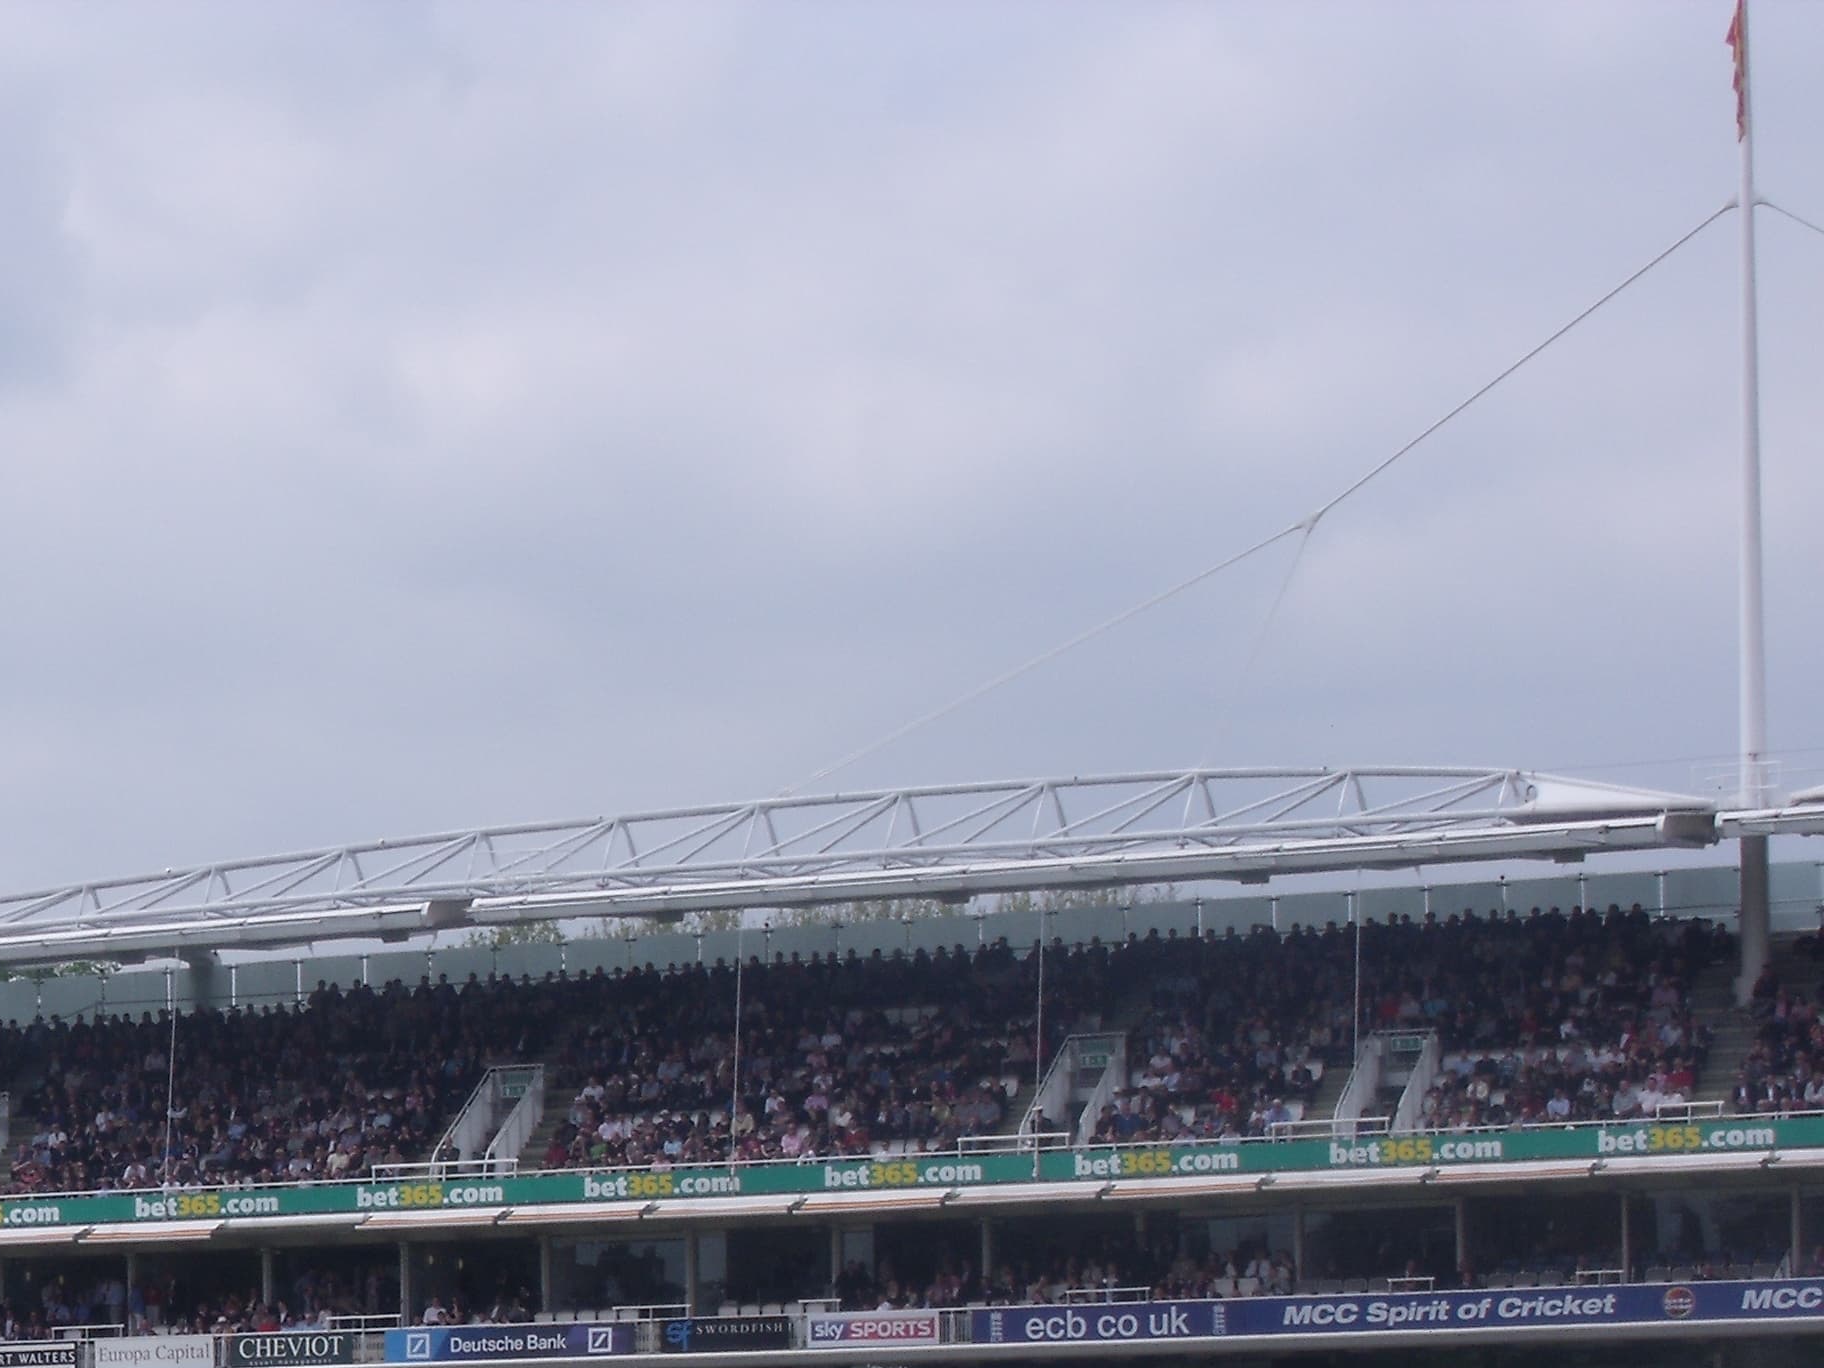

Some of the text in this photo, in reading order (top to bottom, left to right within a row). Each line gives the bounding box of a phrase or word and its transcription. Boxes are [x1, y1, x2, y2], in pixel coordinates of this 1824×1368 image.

[1598, 1126, 1775, 1152] bet365.com
[1329, 1139, 1502, 1164] bet365.com
[824, 1162, 982, 1187] bet365.com
[1074, 1151, 1239, 1176] bet365.com
[356, 1185, 504, 1208] bet365.com
[584, 1174, 741, 1198] bet365.com
[135, 1195, 279, 1218] bet365.com
[1741, 1287, 1823, 1310] MCC
[1025, 1305, 1190, 1339] ecb co uk
[1282, 1294, 1617, 1327] MCC Spirit of Cricket
[814, 1319, 931, 1338] sky SPORTS
[239, 1335, 344, 1358] CHEVIOT
[450, 1332, 567, 1353] Deutsche Bank
[17, 1350, 76, 1365] WALTERS
[98, 1344, 210, 1365] Europa Capital
